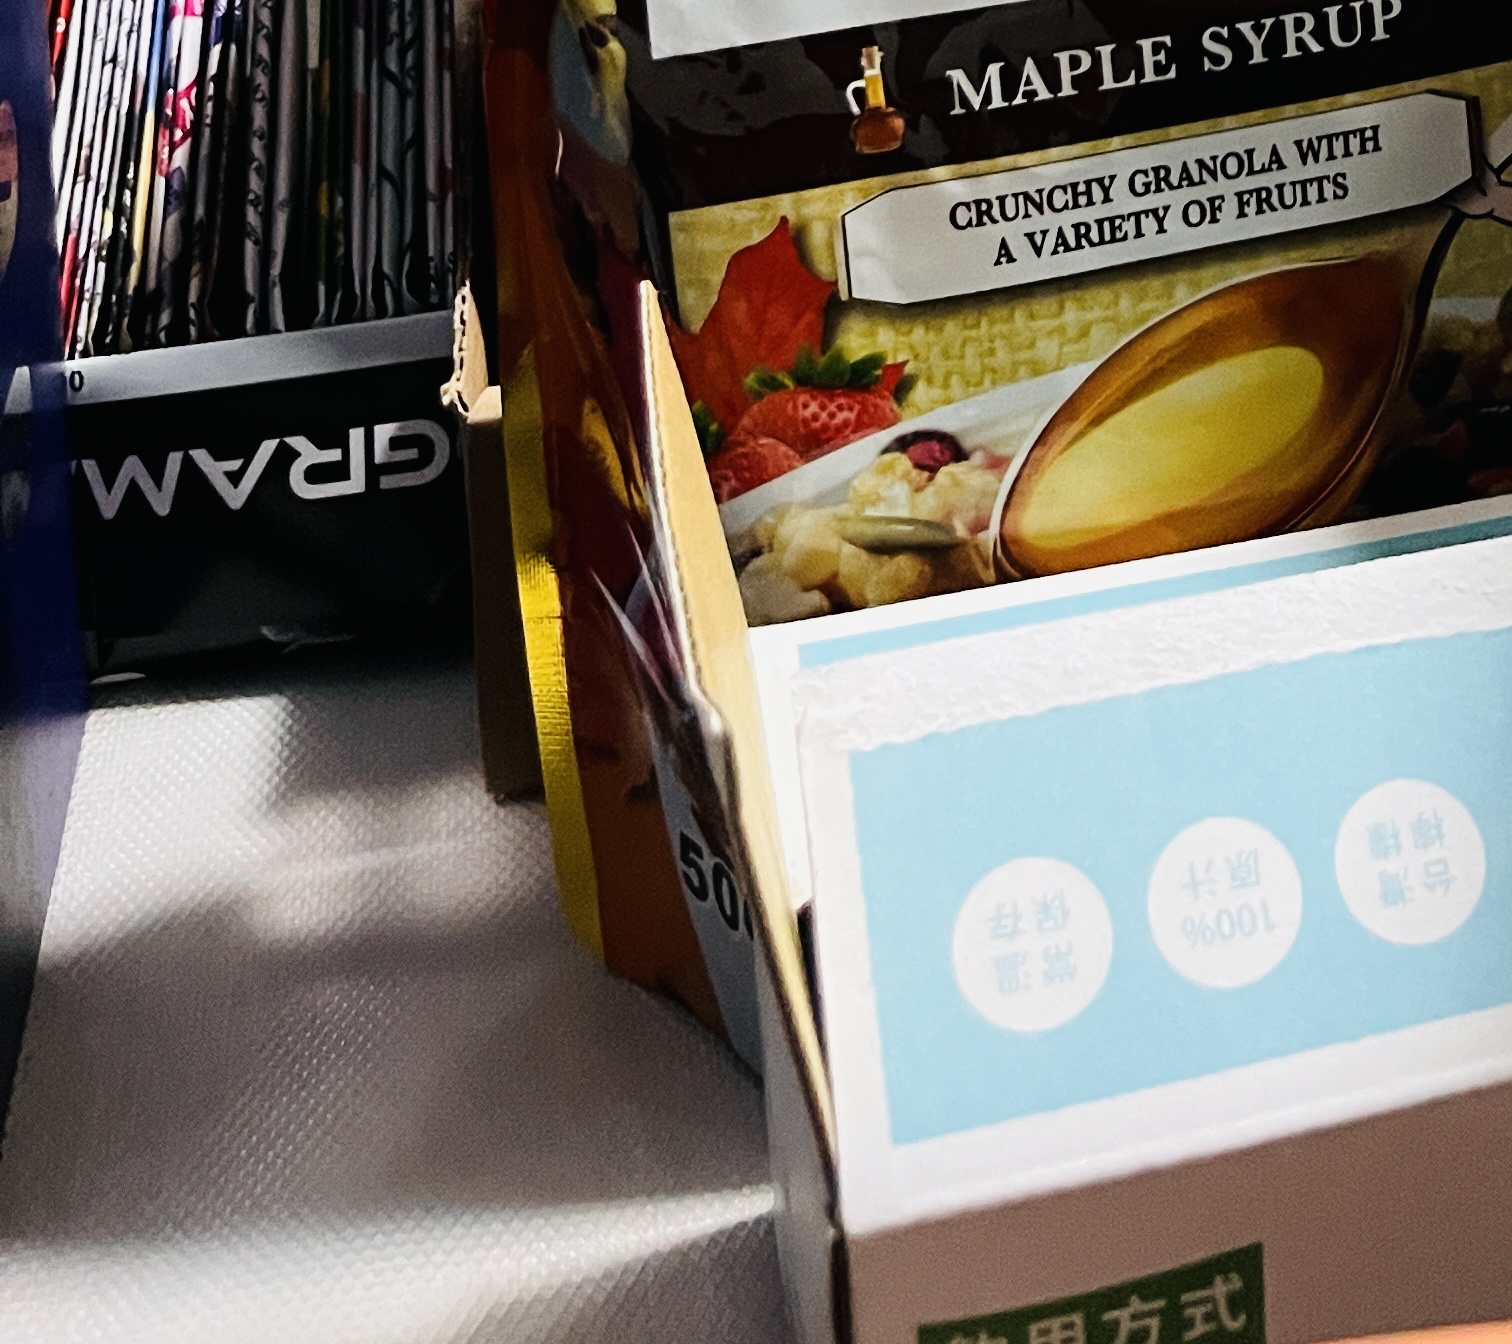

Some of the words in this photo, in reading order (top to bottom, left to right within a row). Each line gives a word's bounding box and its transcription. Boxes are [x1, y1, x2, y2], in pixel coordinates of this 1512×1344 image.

[945, 34, 1177, 116] MAPLE
[948, 171, 1118, 232] CRUNCHY
[1126, 140, 1286, 201] GRANOLA
[1293, 124, 1382, 174] WITH
[992, 235, 1016, 267] A
[1023, 204, 1174, 261] VARIETY
[1181, 196, 1227, 229] OF
[1233, 171, 1349, 221] FRUITS
[69, 419, 450, 520] GRAM
[679, 829, 754, 940] 50
[1181, 848, 1263, 898] 原汁
[984, 892, 1070, 943] 保存
[1181, 899, 1276, 949] 100%
[947, 1272, 1248, 1344] 用方式
